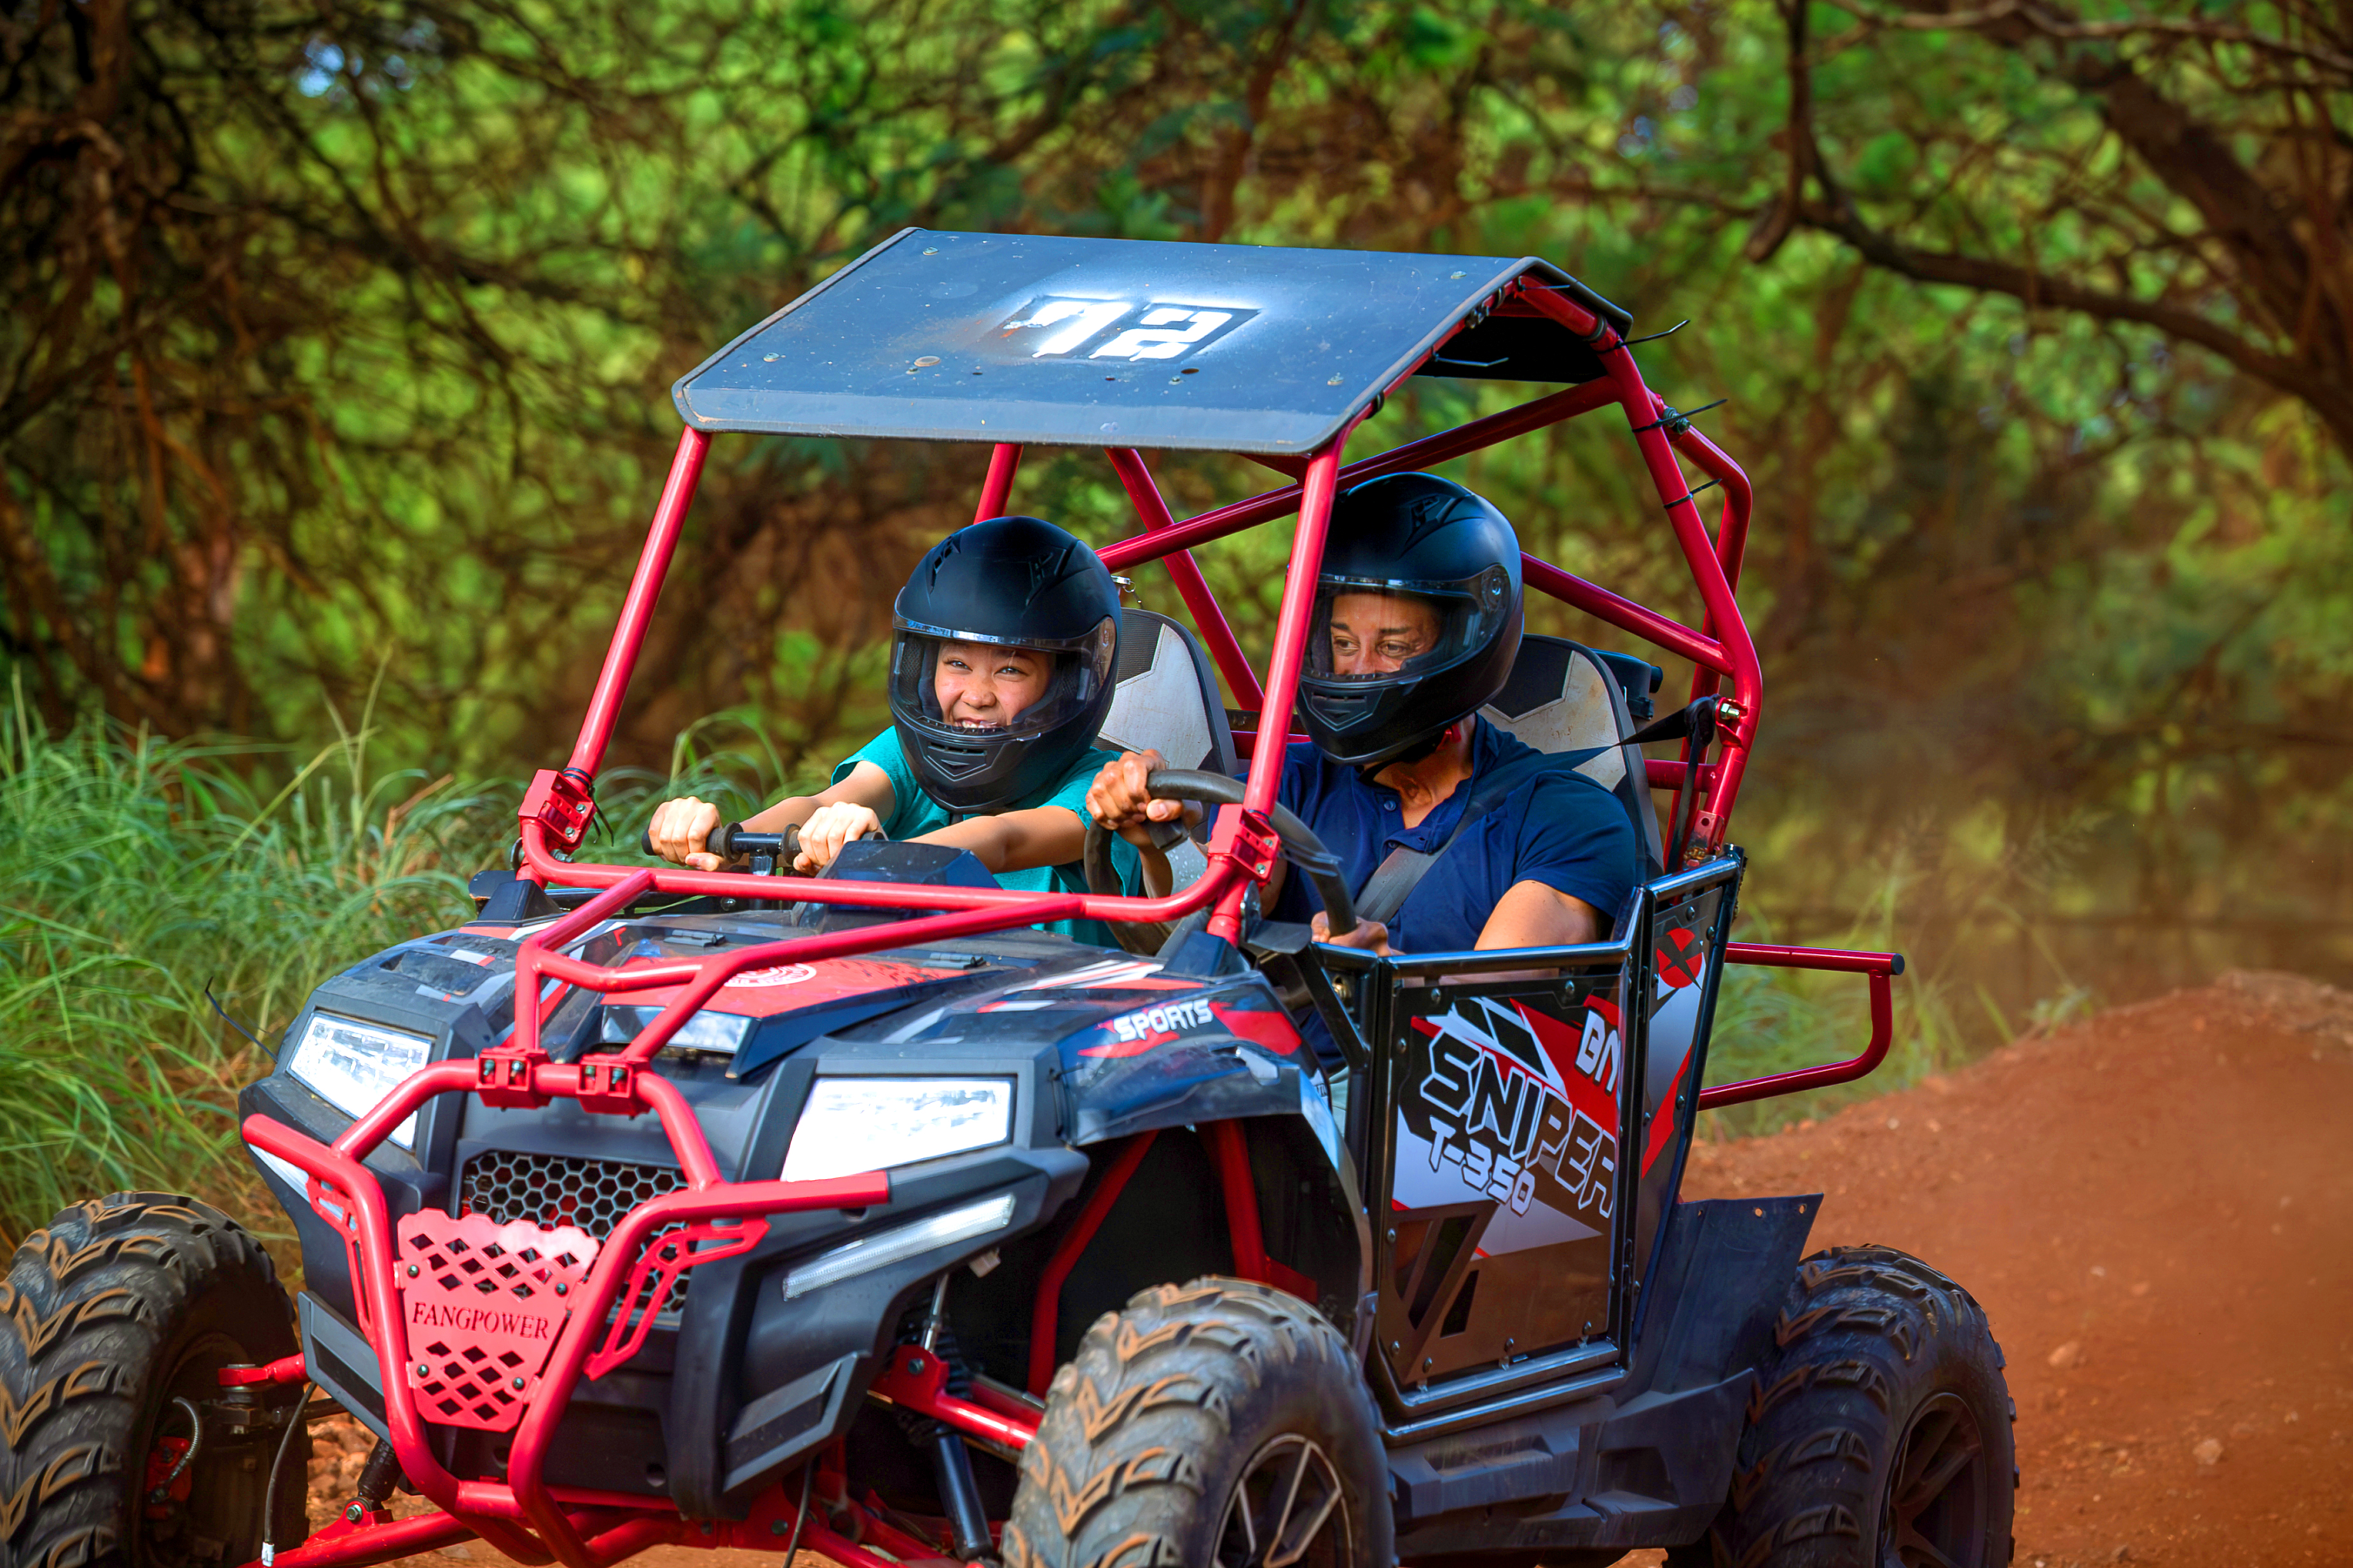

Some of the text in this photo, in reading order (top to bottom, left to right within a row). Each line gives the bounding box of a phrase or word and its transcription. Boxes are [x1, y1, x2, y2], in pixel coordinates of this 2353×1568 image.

[1003, 301, 1233, 362] 72
[1113, 998, 1213, 1042] SPORTS
[1420, 1028, 1617, 1218] SNIPER
[1429, 1114, 1535, 1218] T-350
[412, 1302, 548, 1340] FANGPOWER
